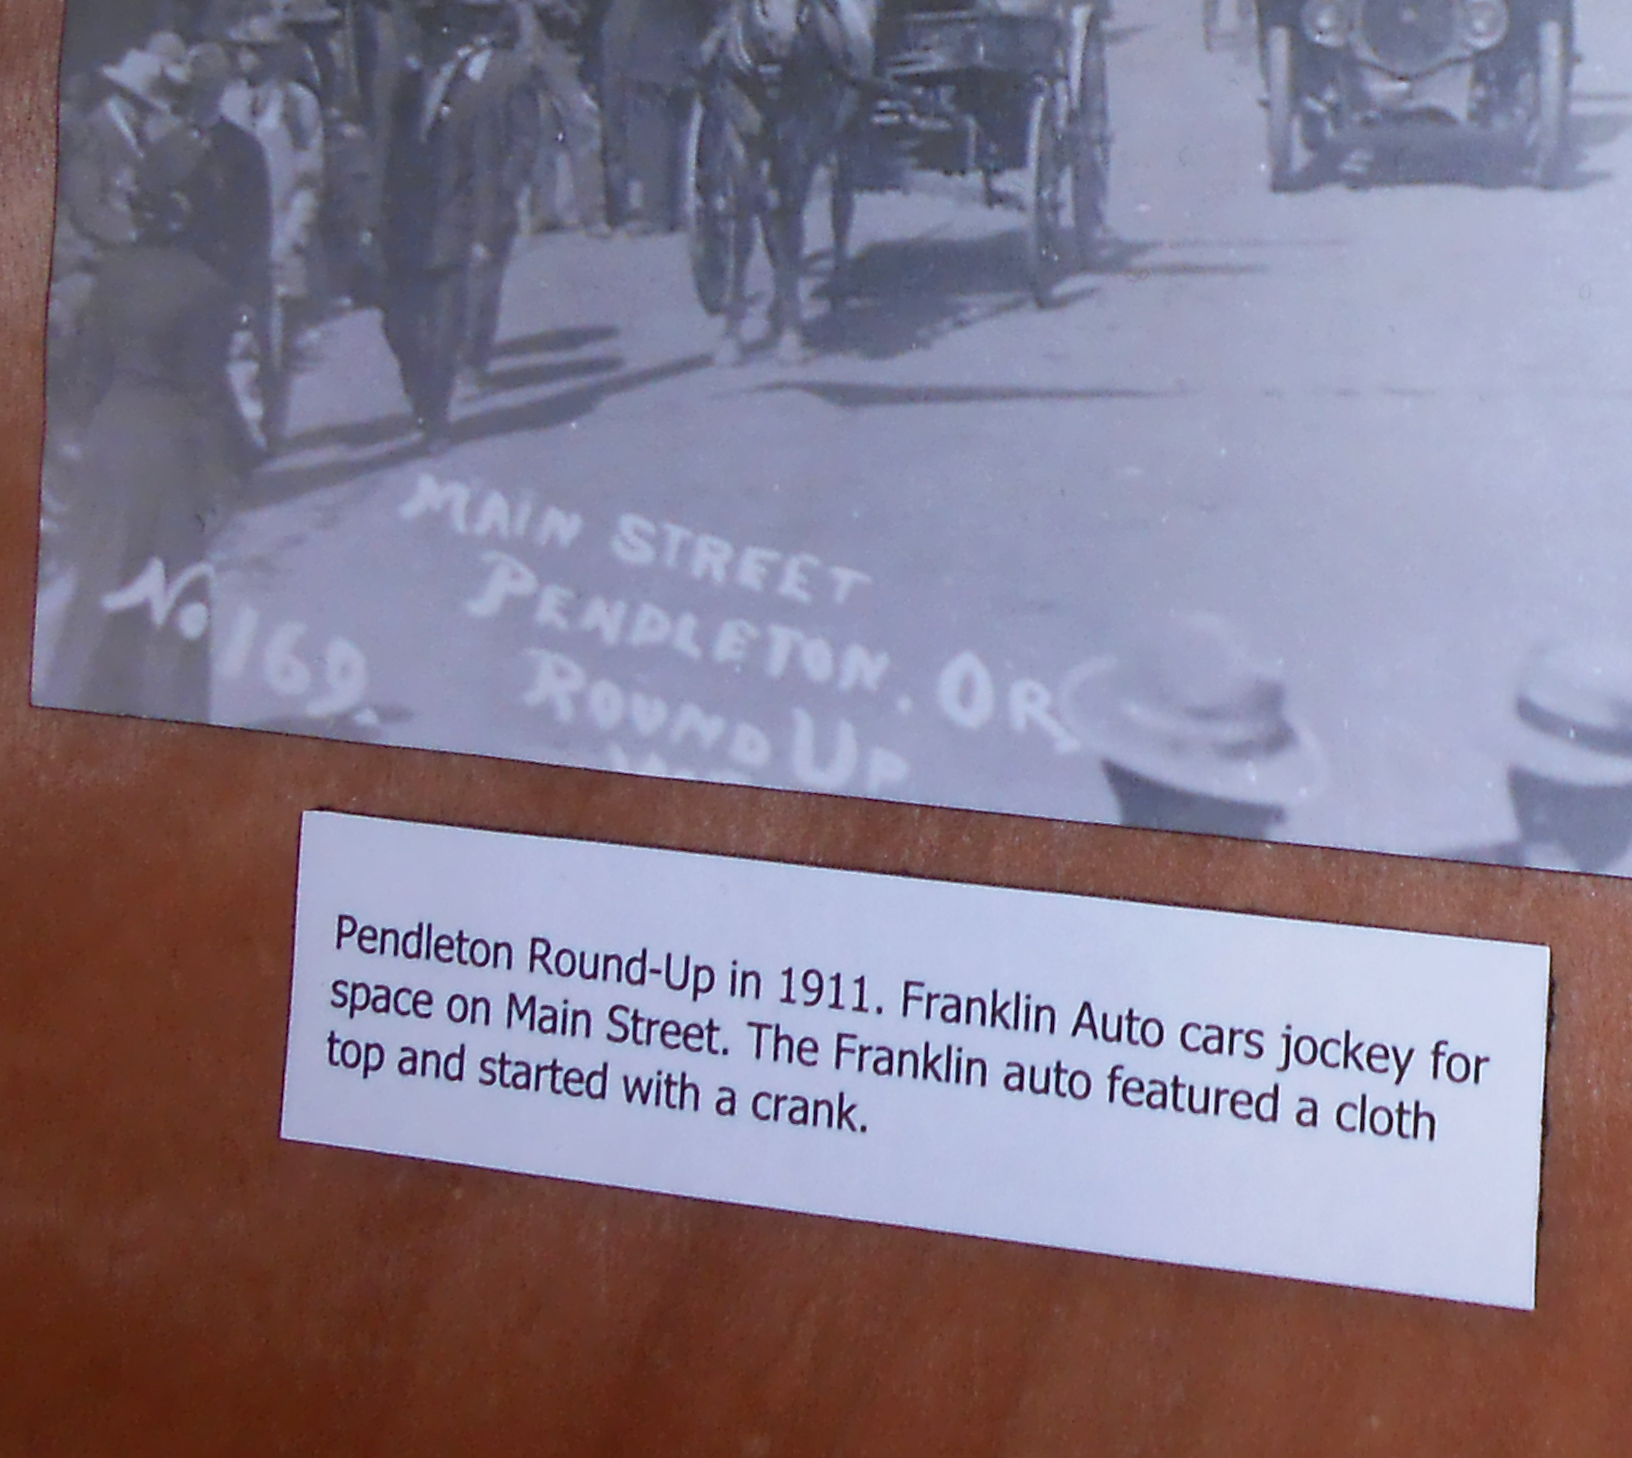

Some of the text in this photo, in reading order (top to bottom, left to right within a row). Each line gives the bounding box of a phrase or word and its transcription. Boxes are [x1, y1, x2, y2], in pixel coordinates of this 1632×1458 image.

[401, 473, 872, 604] MAIN STREET
[522, 647, 773, 768] ROUND
[330, 979, 1437, 1143] space on Main Street. The Franklin auto featured a cloth
[335, 913, 1491, 1087] Pendleton Round-Up in 1911. Franklin Auto cars jockey for
[326, 1029, 868, 1134] top and started with a crank.
